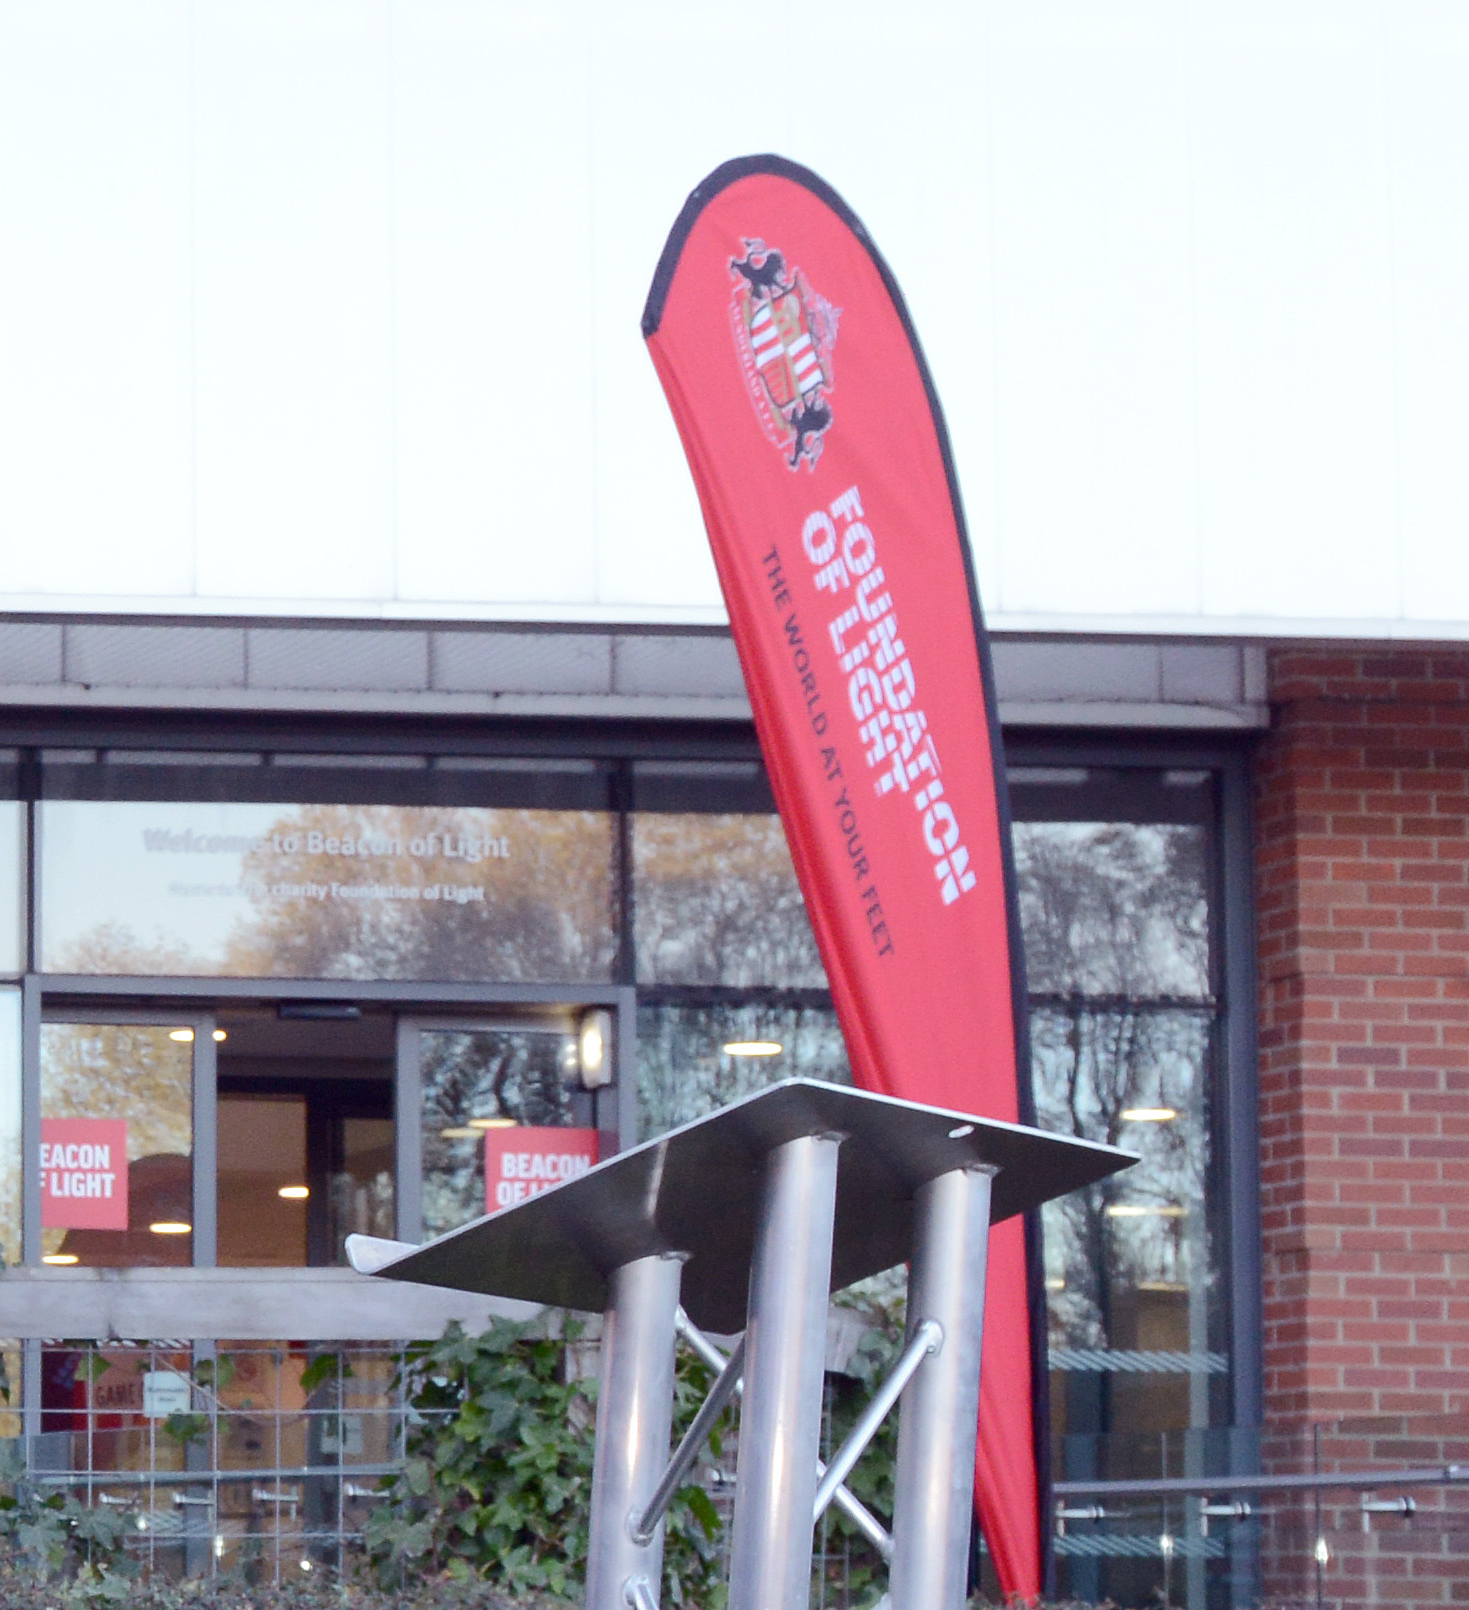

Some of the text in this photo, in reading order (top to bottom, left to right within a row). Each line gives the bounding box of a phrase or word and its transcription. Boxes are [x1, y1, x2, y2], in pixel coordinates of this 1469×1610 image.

[802, 511, 910, 797] OF LIGHT
[830, 485, 976, 906] FOUNDATION
[762, 544, 894, 958] THE WORLD AT YOUR FEET
[143, 828, 510, 863] Welcome to Beacon of Light
[271, 883, 328, 901] charity
[331, 883, 420, 901] Foundation
[424, 884, 443, 901] of
[445, 886, 485, 904] Light
[40, 1143, 110, 1169] EACON
[502, 1153, 591, 1179] BEACON
[51, 1171, 115, 1198] LIGHT
